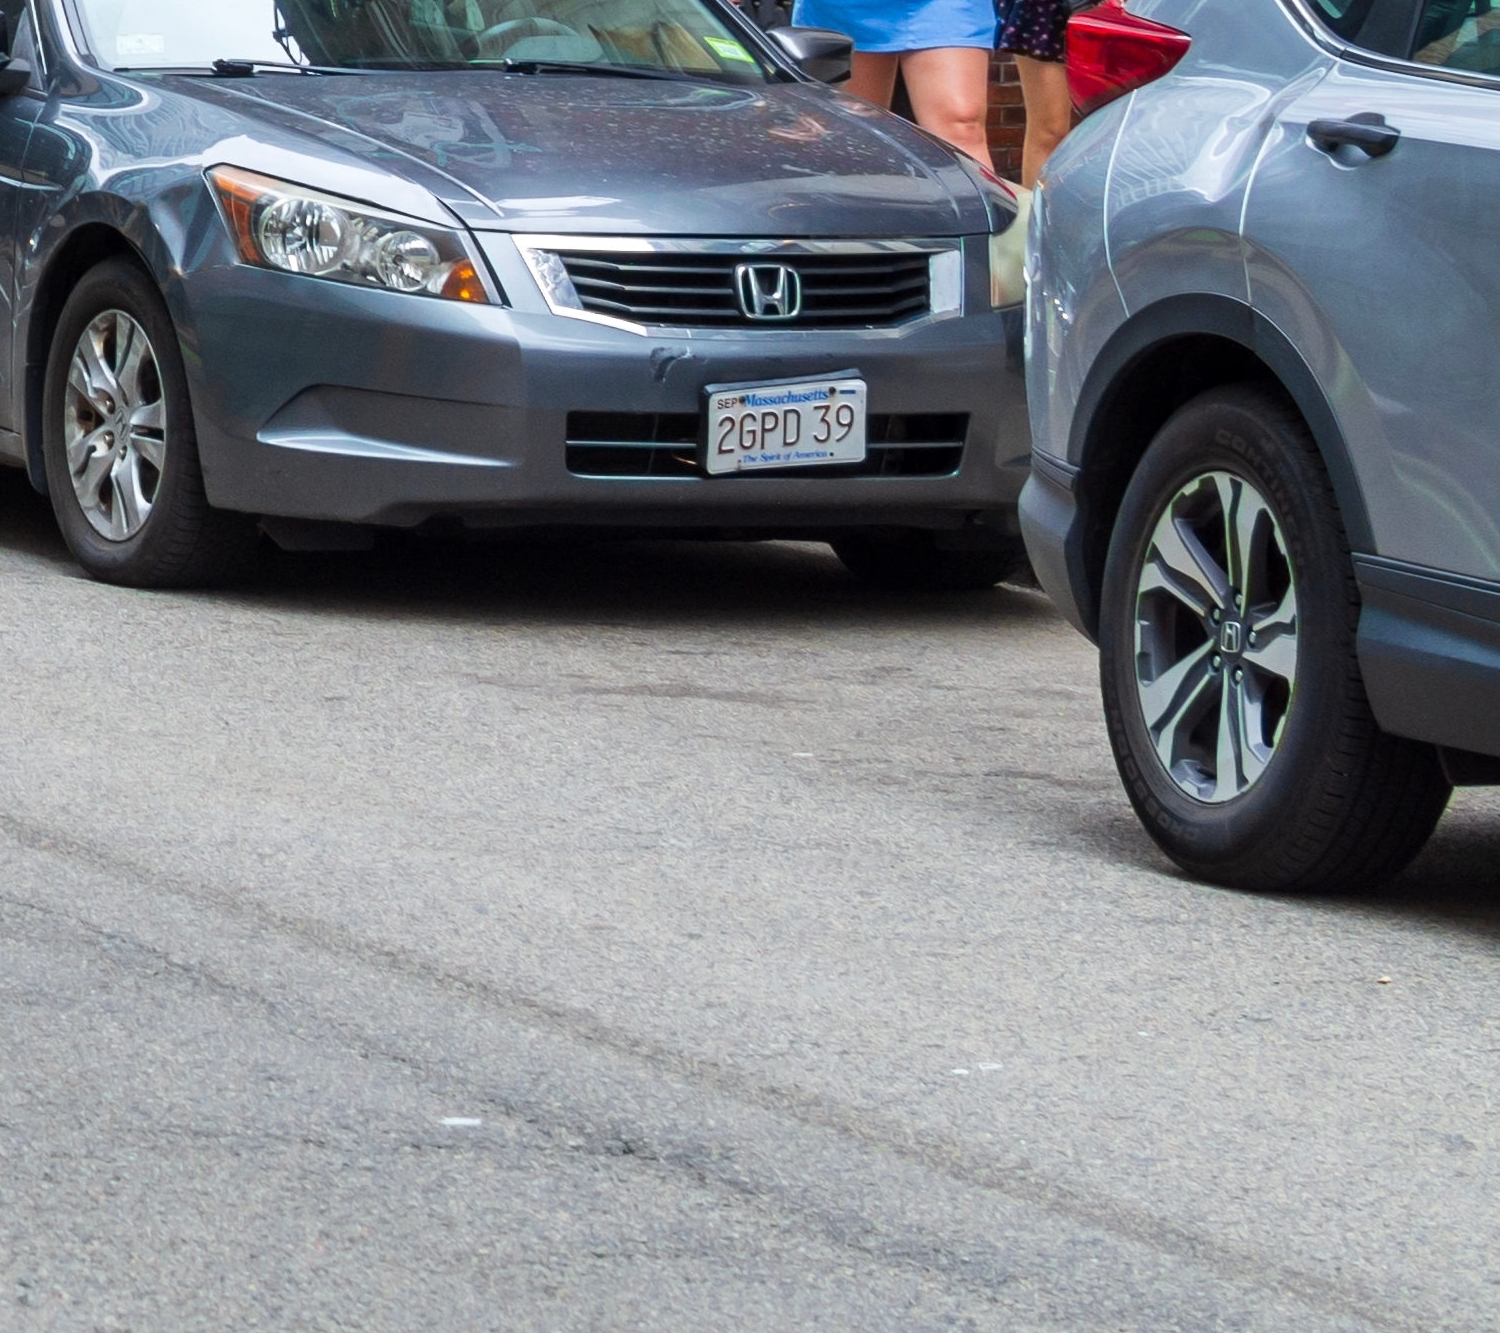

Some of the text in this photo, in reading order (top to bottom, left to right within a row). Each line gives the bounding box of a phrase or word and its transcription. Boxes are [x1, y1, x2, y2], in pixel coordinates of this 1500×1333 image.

[717, 390, 829, 409] SEP Massachusetts
[718, 402, 855, 455] 2GPD 39
[743, 450, 828, 463] The Spirit of America
